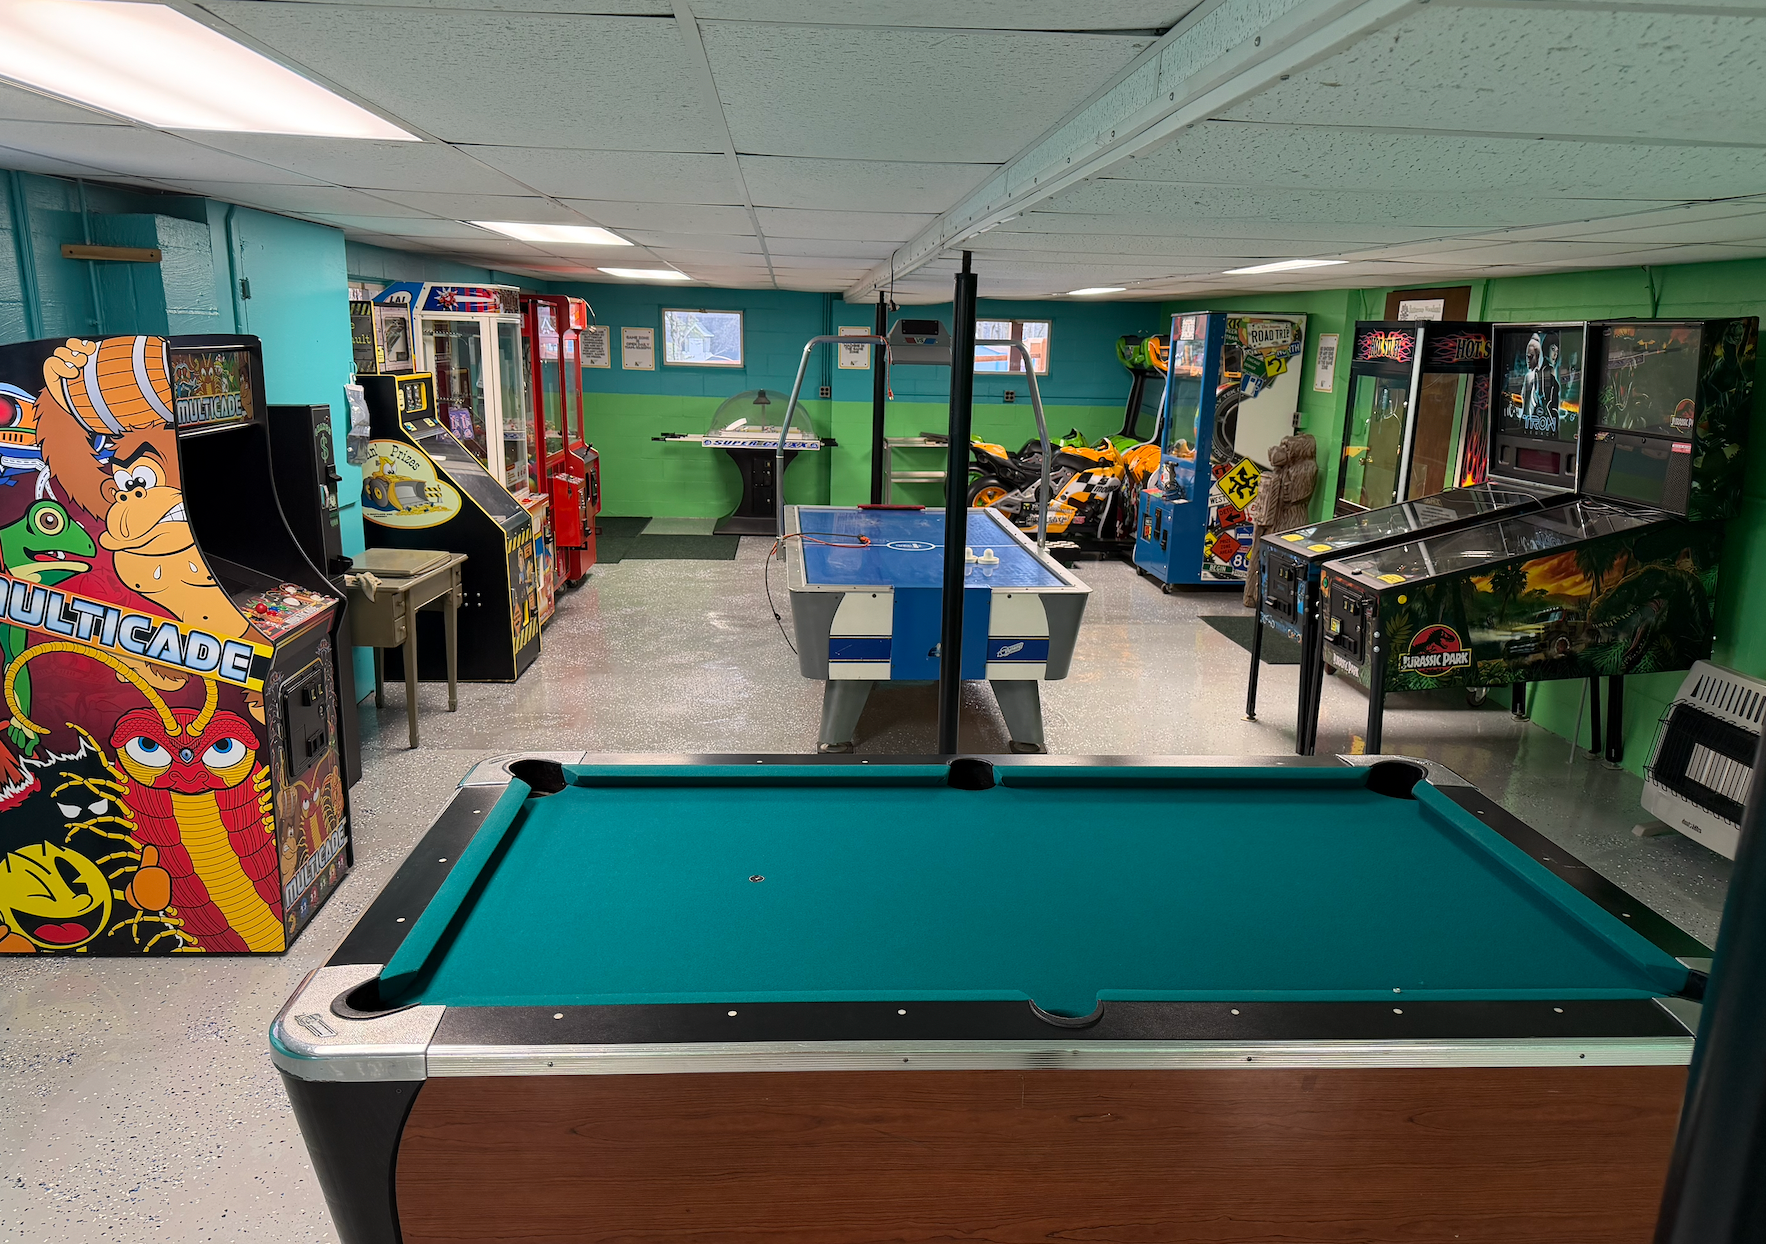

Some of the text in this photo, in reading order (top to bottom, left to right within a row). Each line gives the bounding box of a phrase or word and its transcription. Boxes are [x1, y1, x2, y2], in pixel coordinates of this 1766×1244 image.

[1251, 330, 1274, 343] ROAD
[1275, 329, 1290, 340] TRIP
[1456, 338, 1482, 359] HOT
[177, 394, 242, 424] MULTICADE
[1523, 415, 1557, 432] TRON
[390, 444, 420, 471] Prizes
[0, 575, 254, 684] ULTICADE
[1402, 652, 1469, 669] JURASSIC PARK
[285, 823, 345, 910] MULTICADE
